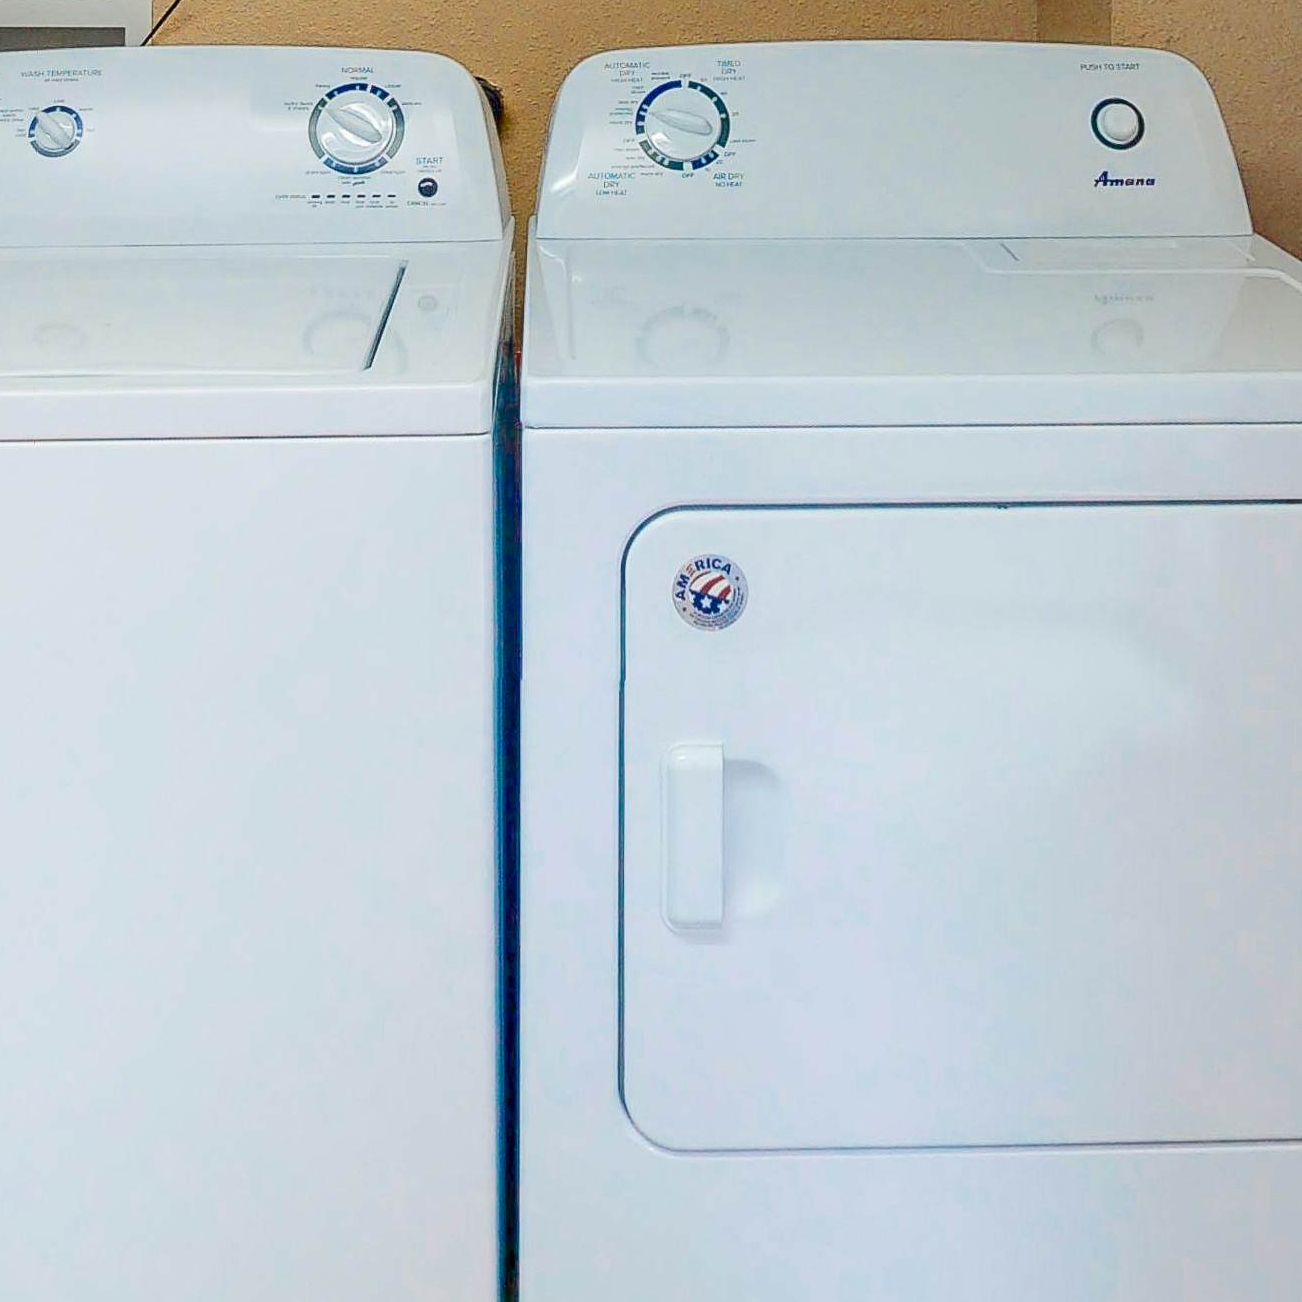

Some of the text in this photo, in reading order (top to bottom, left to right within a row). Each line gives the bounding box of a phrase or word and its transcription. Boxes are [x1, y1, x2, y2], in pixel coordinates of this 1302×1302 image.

[1104, 63, 1115, 71] TO
[1094, 170, 1155, 187] Amana
[675, 558, 732, 601] AMERICA
